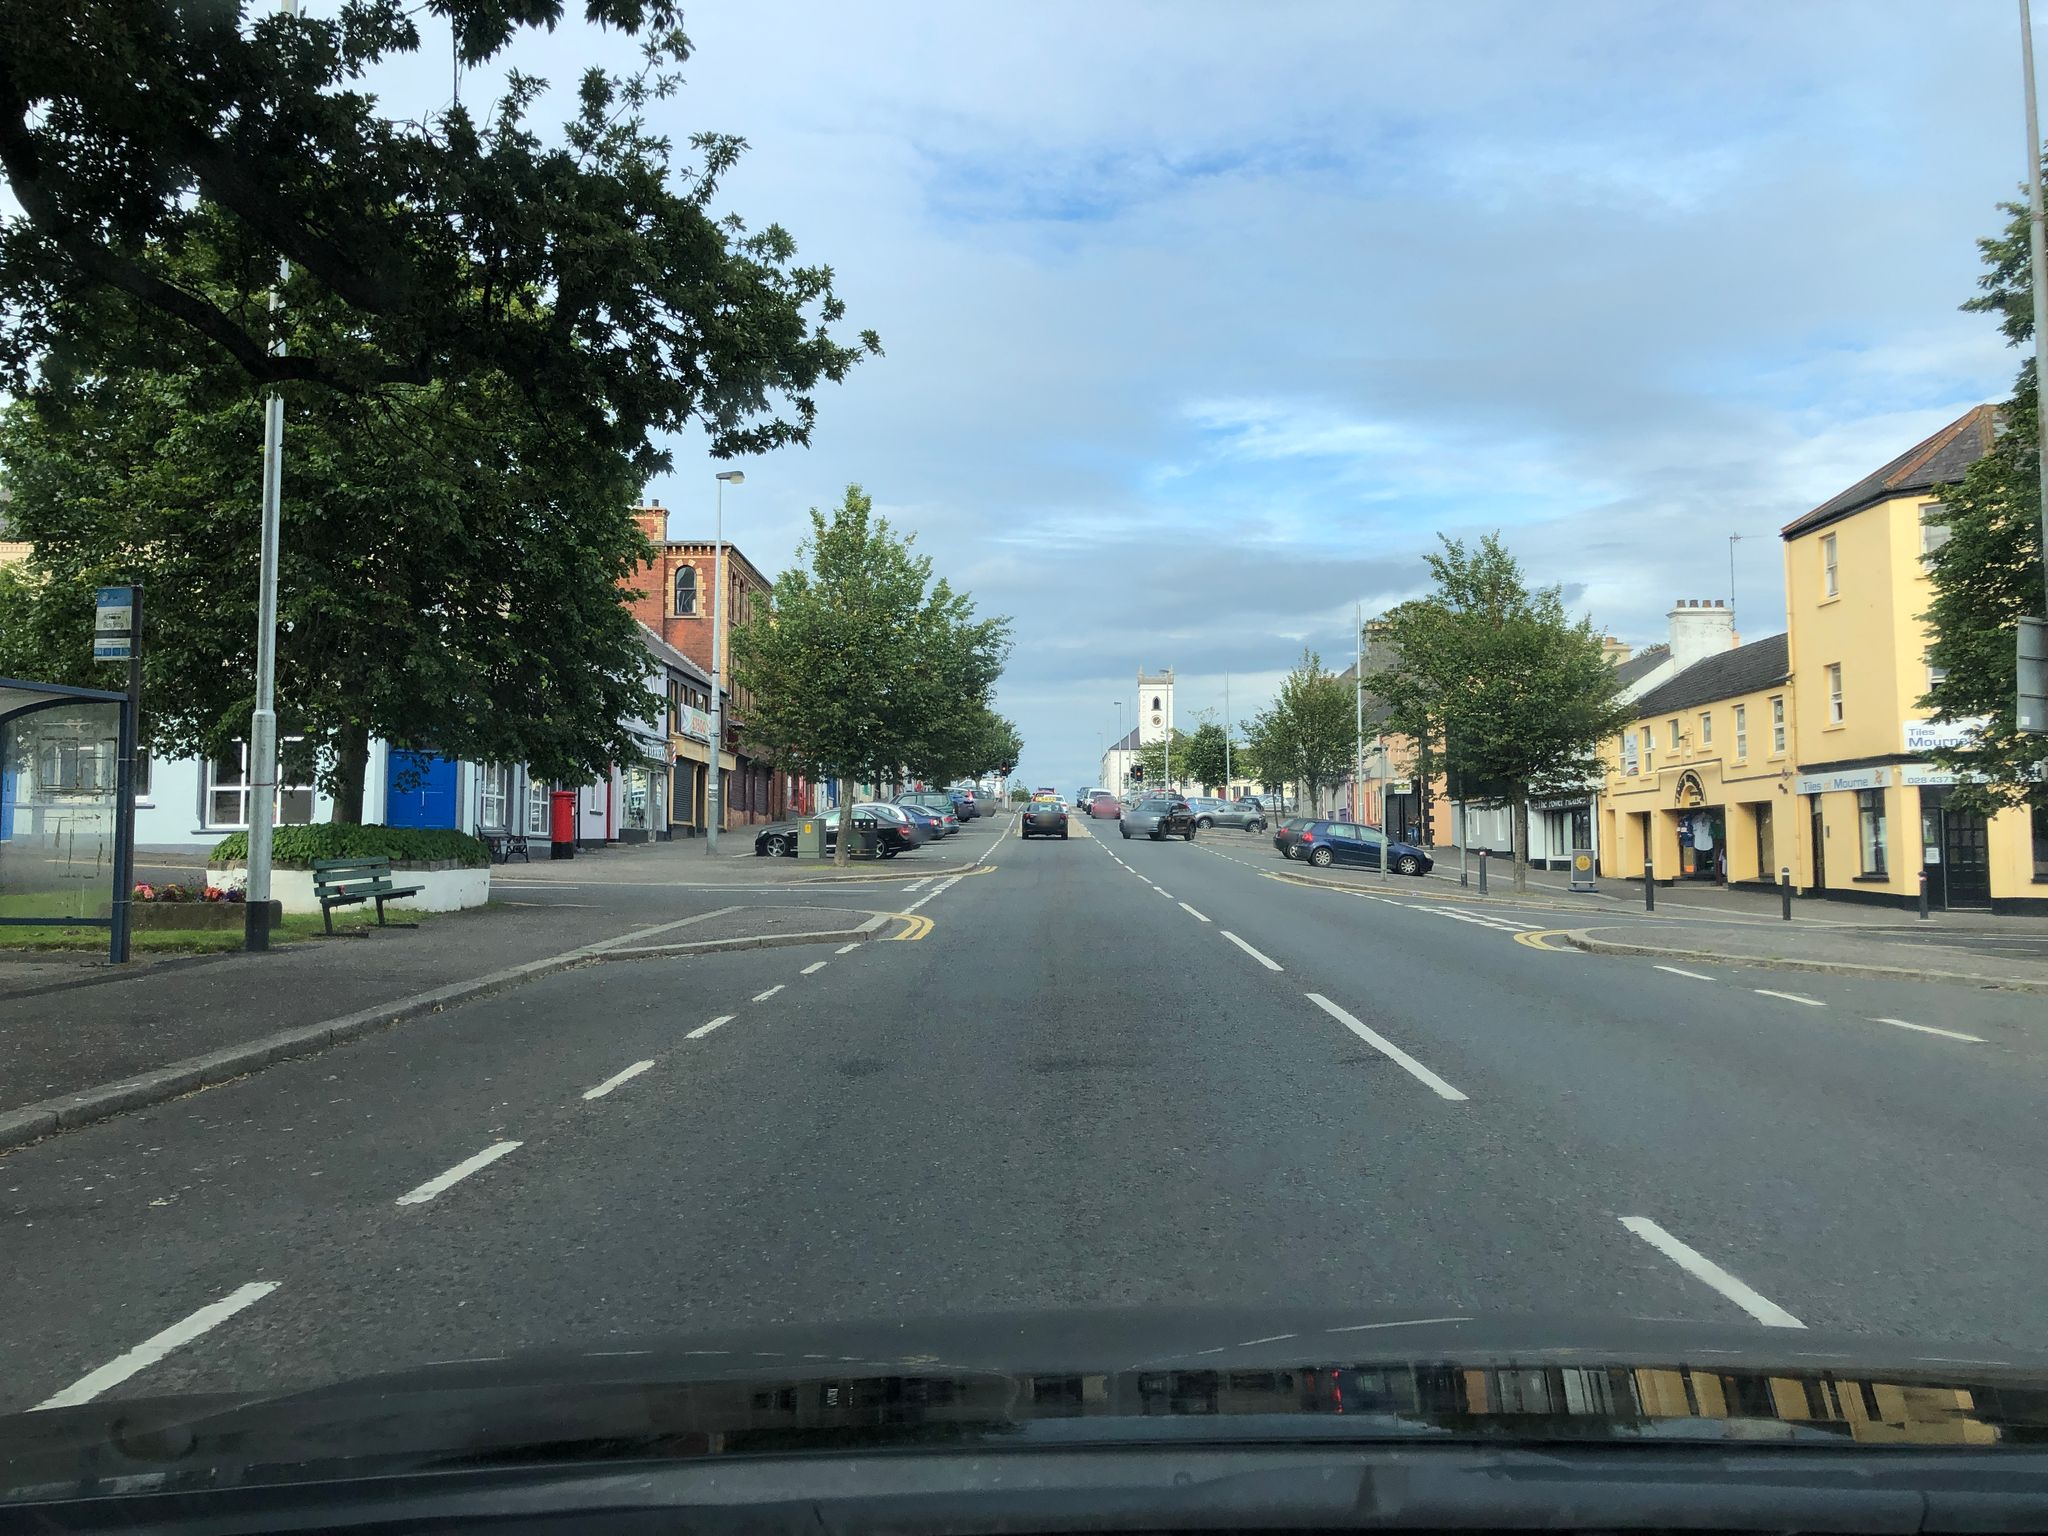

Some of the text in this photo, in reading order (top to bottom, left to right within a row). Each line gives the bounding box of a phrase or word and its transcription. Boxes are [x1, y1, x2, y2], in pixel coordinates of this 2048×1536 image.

[1908, 728, 1936, 736] Tiles
[1803, 781, 1821, 792] Tiles
[1833, 778, 1868, 789] Mourne
